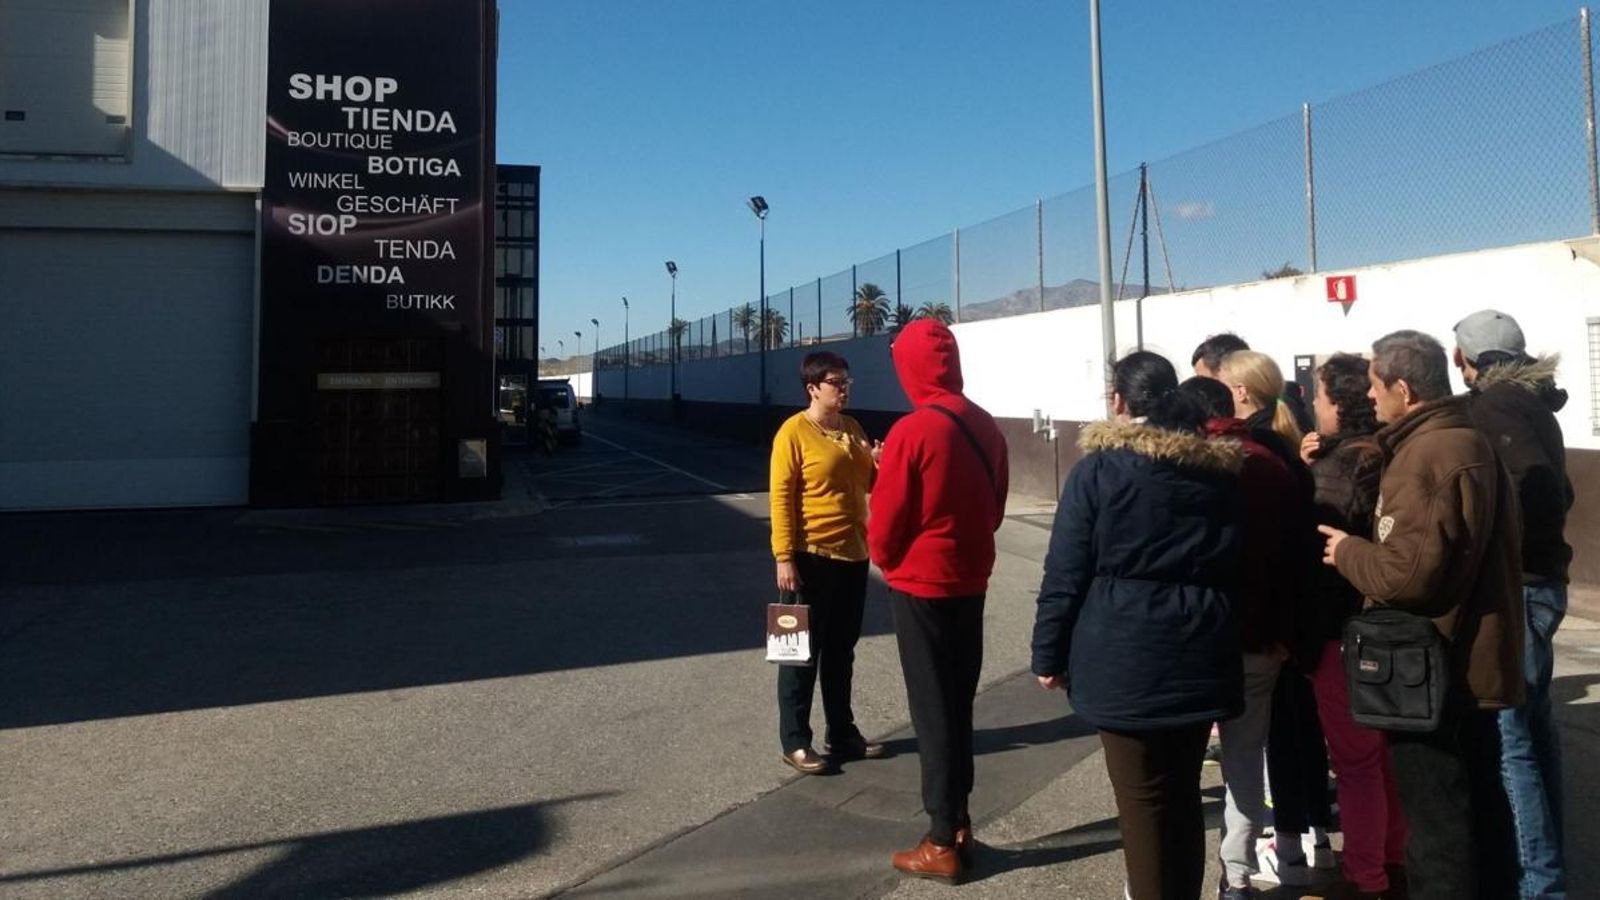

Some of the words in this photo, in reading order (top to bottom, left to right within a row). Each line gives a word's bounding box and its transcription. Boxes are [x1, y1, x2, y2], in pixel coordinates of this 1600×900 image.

[288, 73, 398, 103] SHOP
[341, 106, 457, 133] TIENDA
[287, 131, 393, 150] BOUTIQUE
[368, 156, 461, 177] BOTIGA
[288, 172, 365, 190] WINKEL
[336, 195, 459, 215] GESCHÄFT
[287, 213, 357, 236] SIOP
[374, 239, 456, 260] TENDA
[317, 265, 405, 284] DENDA
[386, 294, 455, 310] BUTIKK
